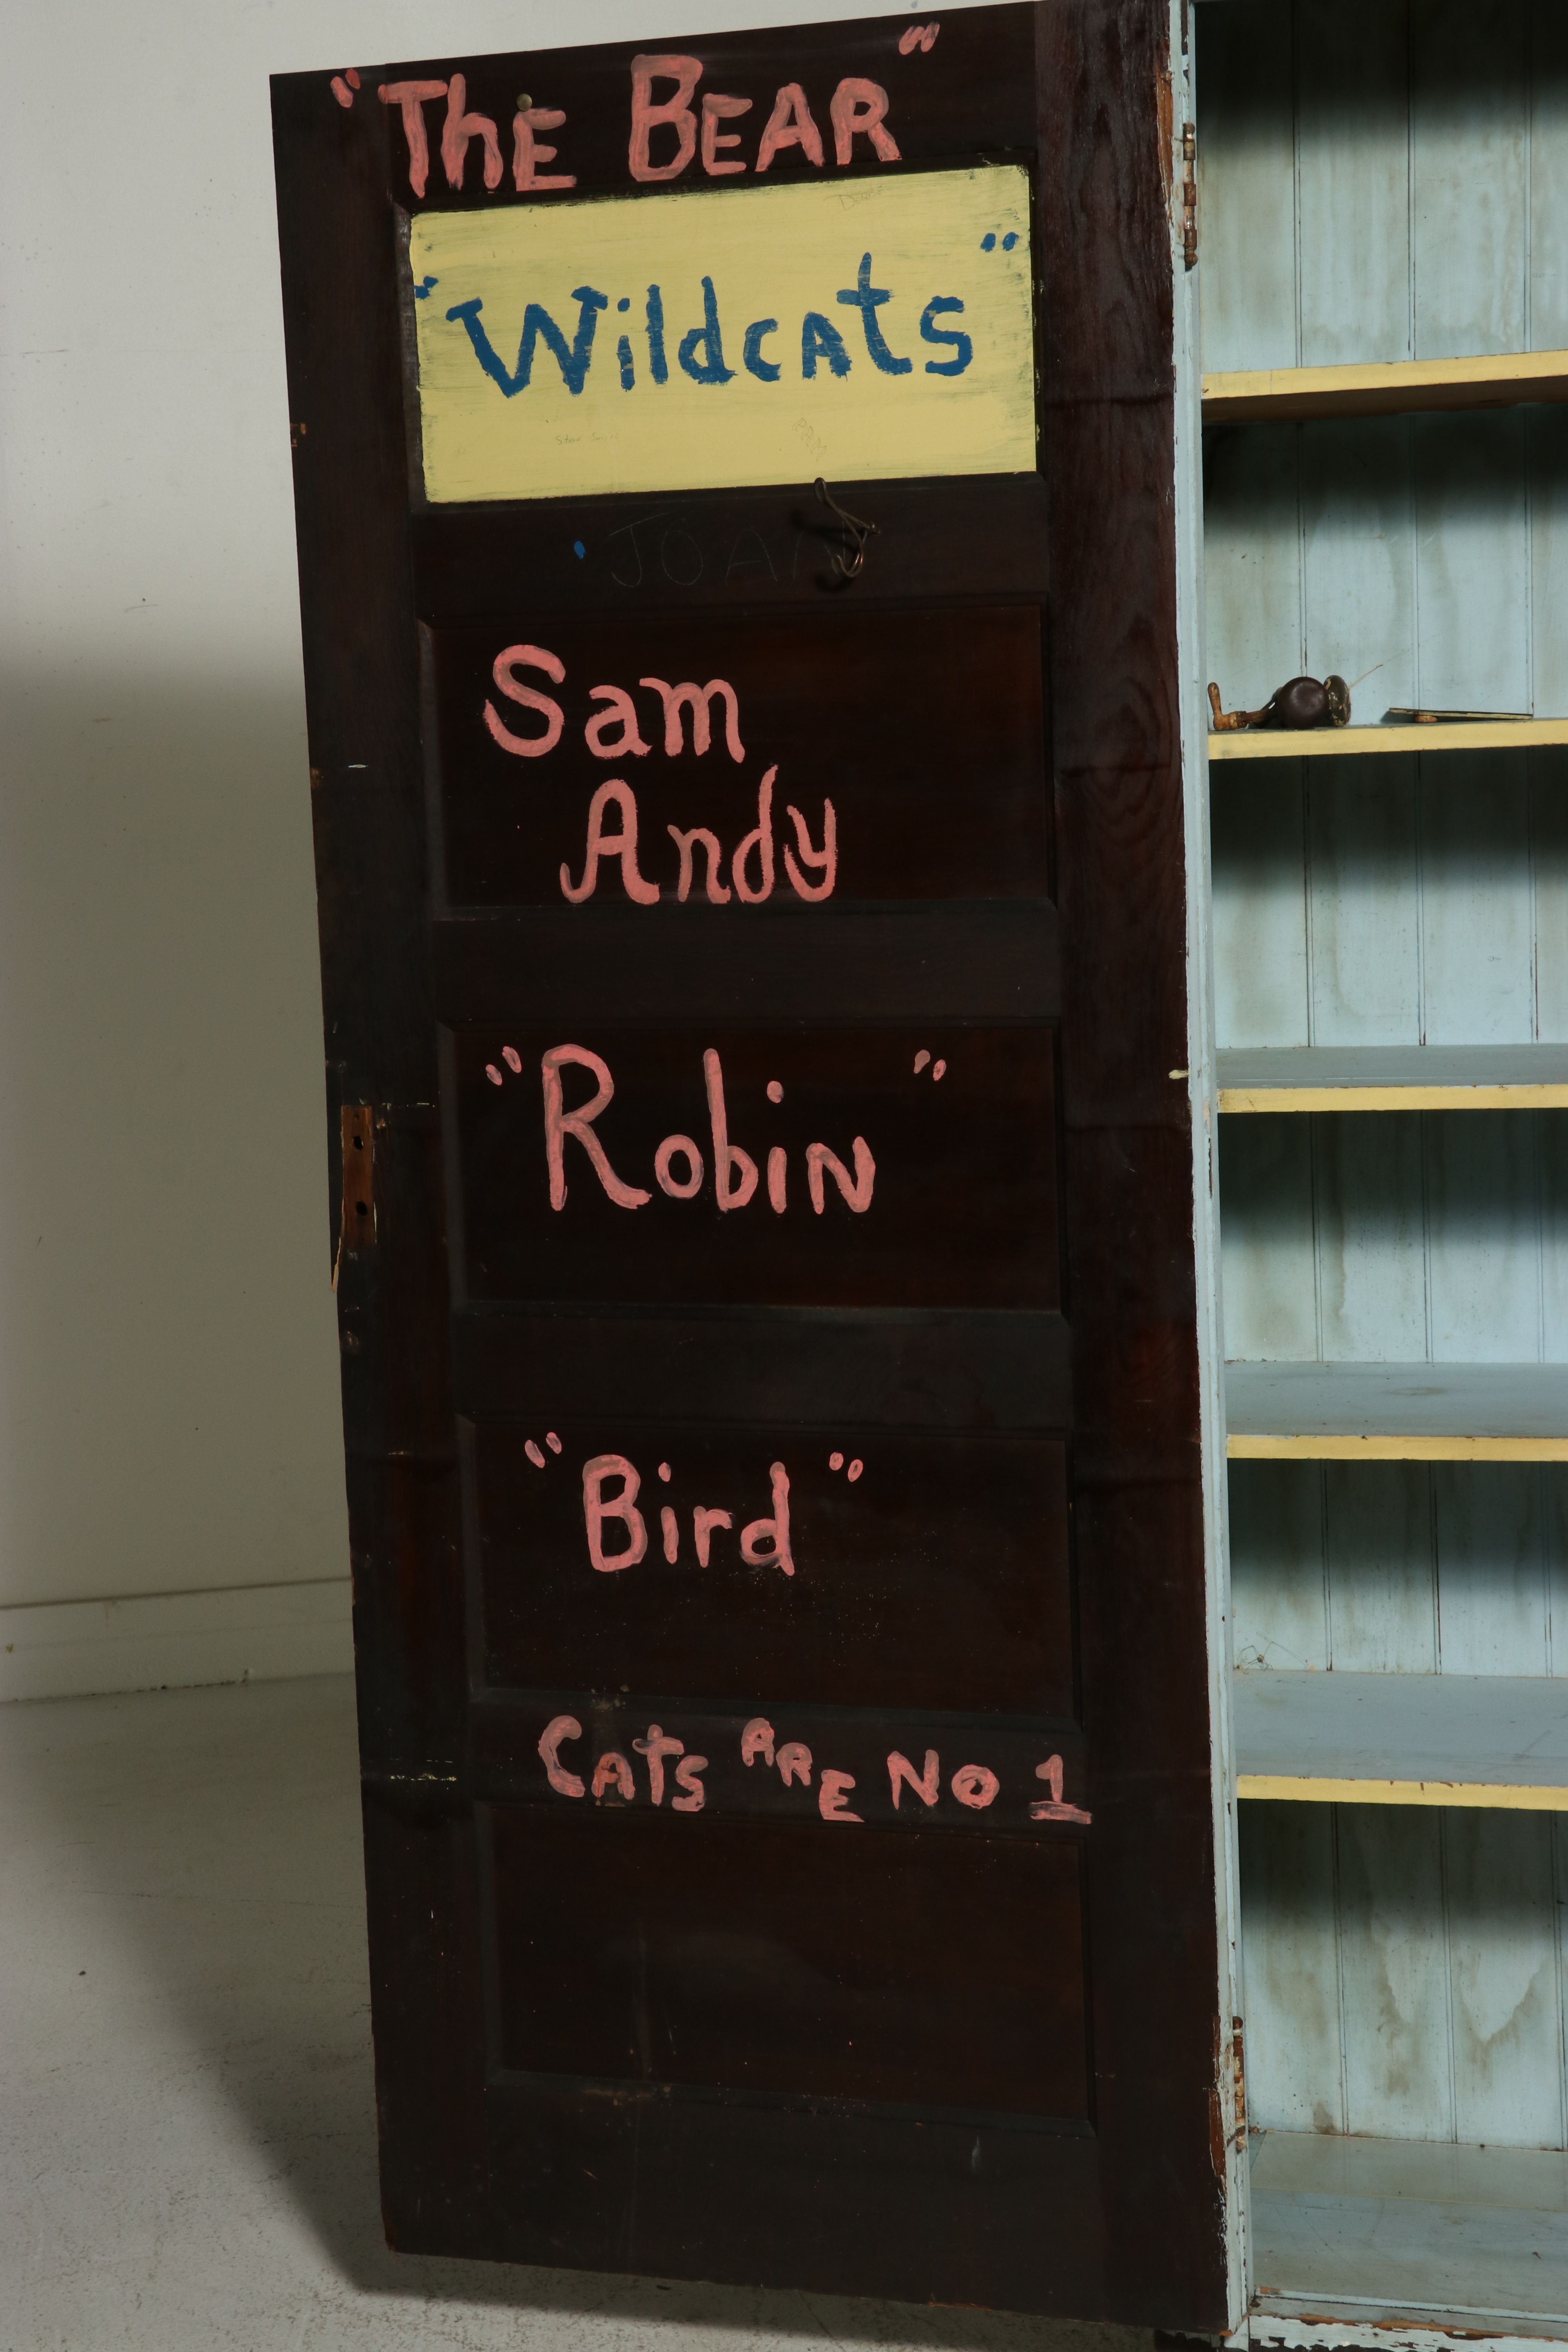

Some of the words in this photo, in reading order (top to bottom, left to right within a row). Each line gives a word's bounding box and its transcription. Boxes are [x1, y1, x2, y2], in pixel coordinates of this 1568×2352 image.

[483, 644, 746, 764] Sam
[559, 764, 838, 905] Andy
[740, 1717, 865, 1823] ARE
[1031, 1754, 1093, 1825] 1
